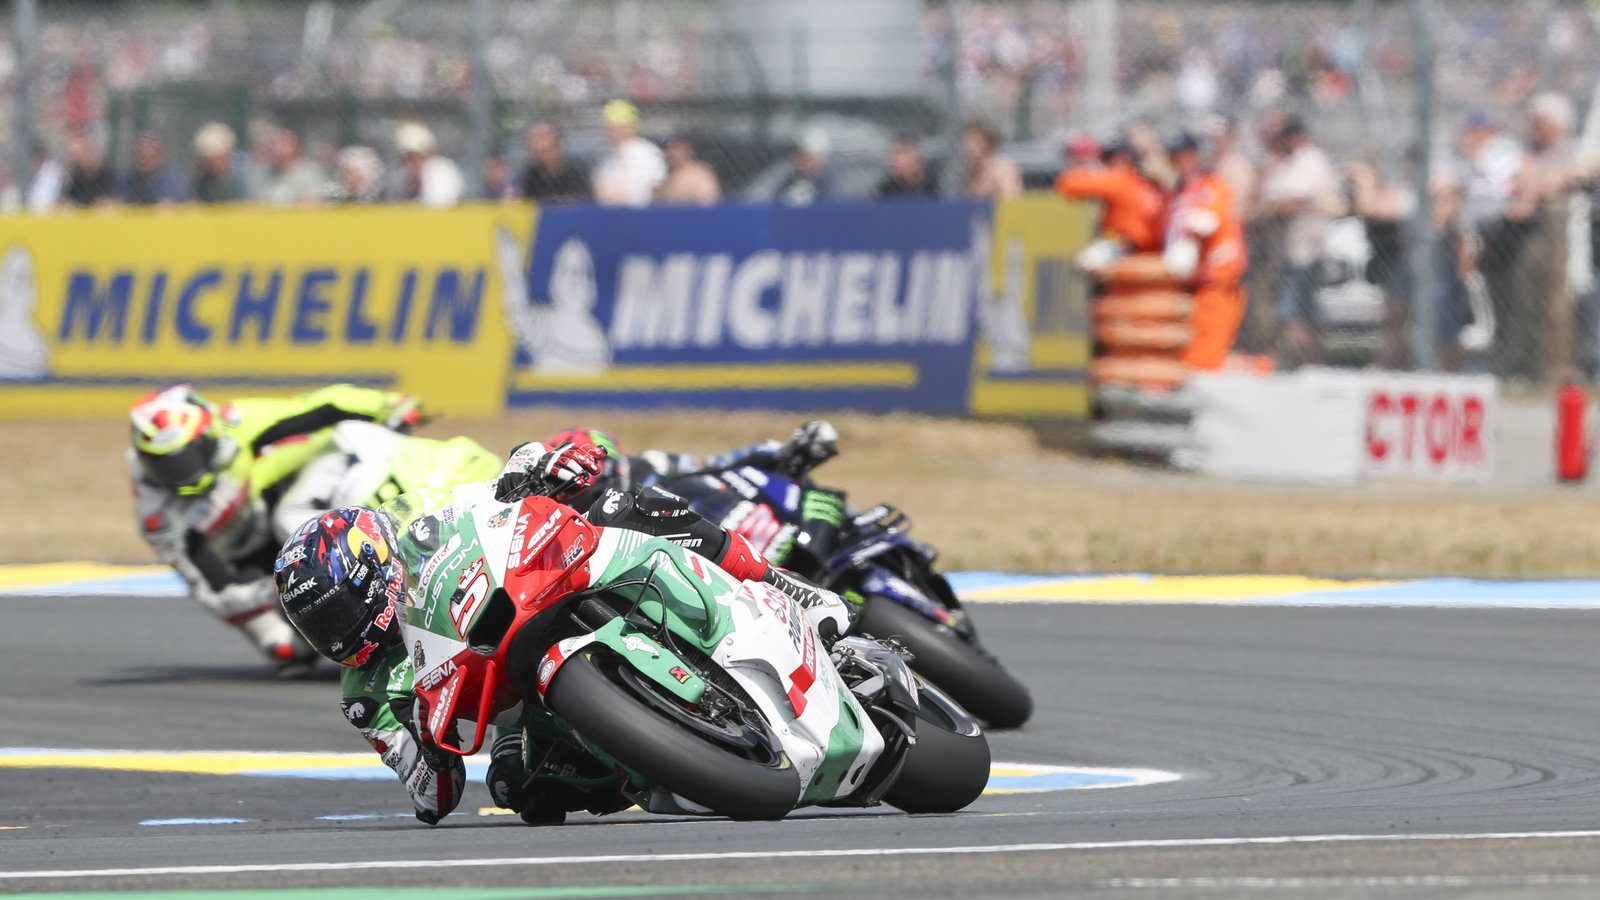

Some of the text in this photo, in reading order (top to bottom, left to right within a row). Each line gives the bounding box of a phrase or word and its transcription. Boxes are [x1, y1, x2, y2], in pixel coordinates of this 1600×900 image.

[58, 266, 486, 344] MICHELIN
[611, 248, 971, 348] MICHELIN
[507, 513, 531, 570] SENA
[522, 525, 562, 565] HONDA
[527, 508, 562, 550] GIVI
[283, 576, 318, 602] SHARK
[425, 538, 479, 630] CUSTOM
[393, 658, 411, 692] SHAR
[422, 660, 458, 691] SENA
[430, 687, 448, 735] GIVI
[440, 676, 459, 728] HONDA
